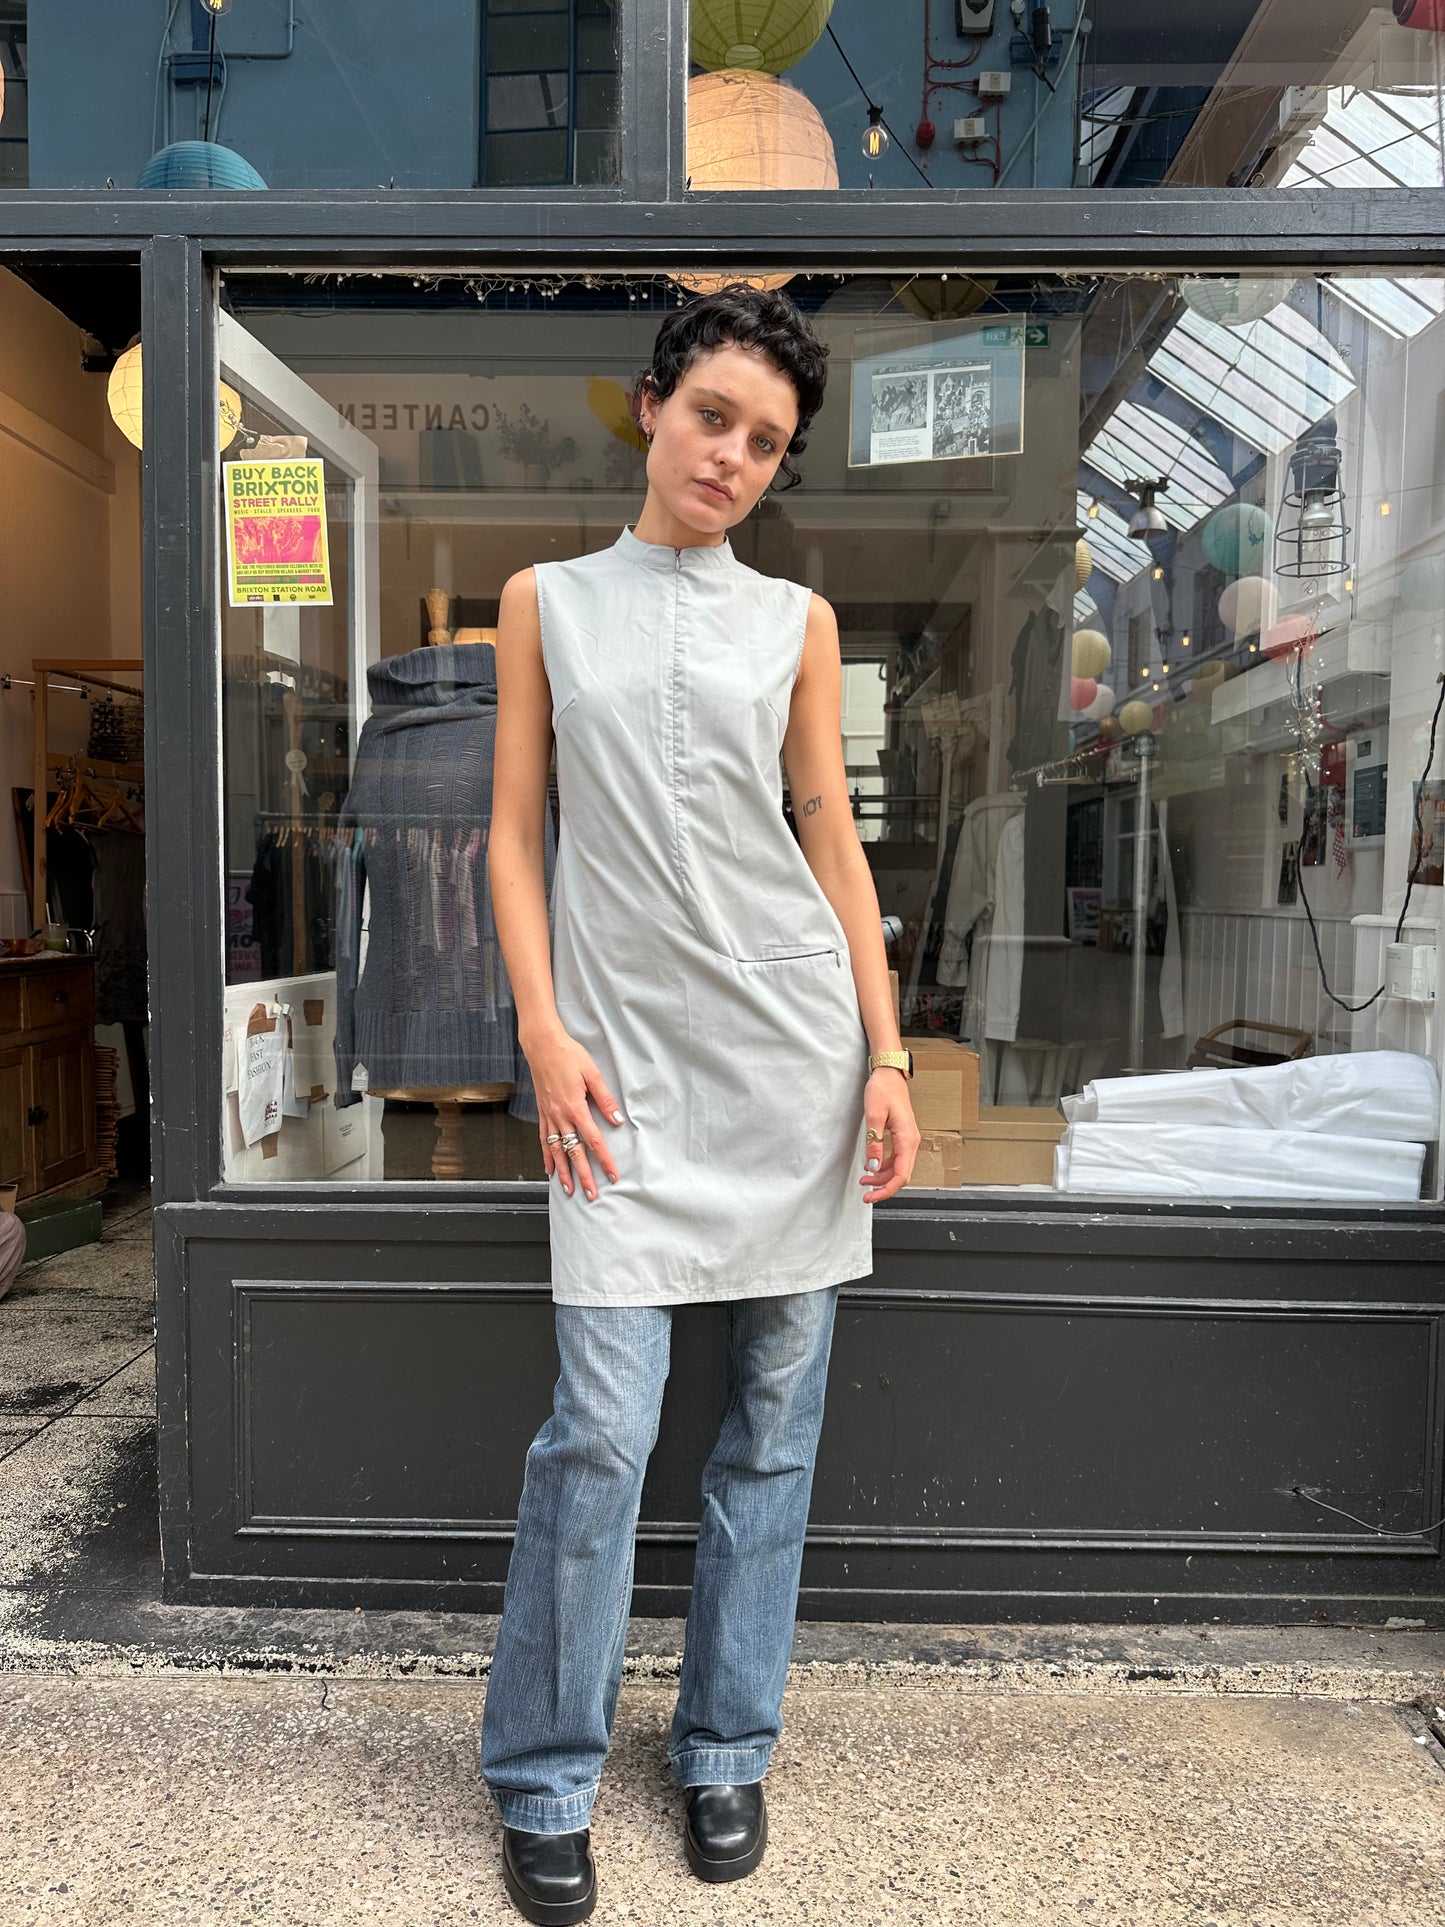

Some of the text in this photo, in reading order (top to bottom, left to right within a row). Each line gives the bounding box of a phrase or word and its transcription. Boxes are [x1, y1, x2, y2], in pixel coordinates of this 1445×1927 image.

[232, 465, 317, 480] BUY BACK
[233, 479, 319, 496] BRIXTON
[233, 496, 318, 508] STREET RALLY
